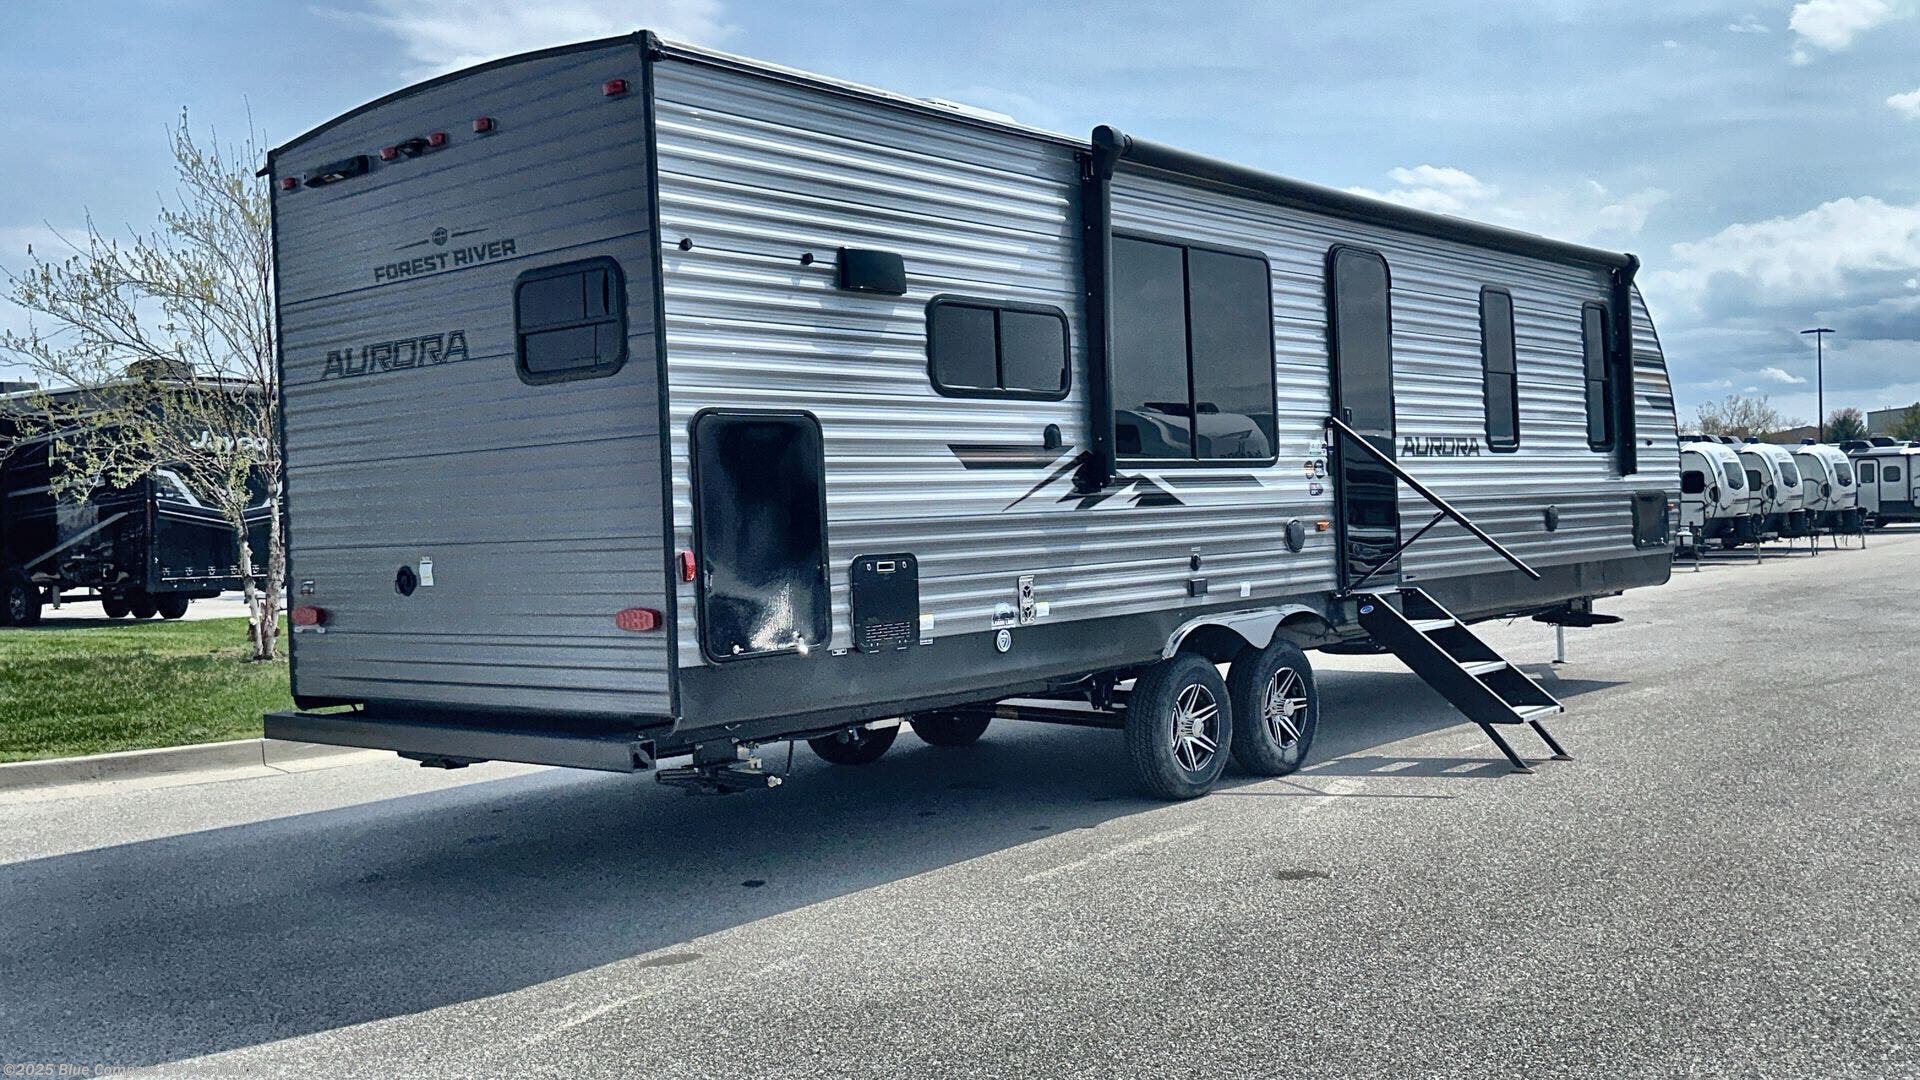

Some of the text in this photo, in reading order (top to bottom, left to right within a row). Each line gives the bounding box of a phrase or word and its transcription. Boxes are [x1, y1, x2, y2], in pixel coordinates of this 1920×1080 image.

[374, 238, 517, 282] FOREST RIVER
[321, 329, 470, 379] AURORA
[1401, 436, 1480, 457] AURORA
